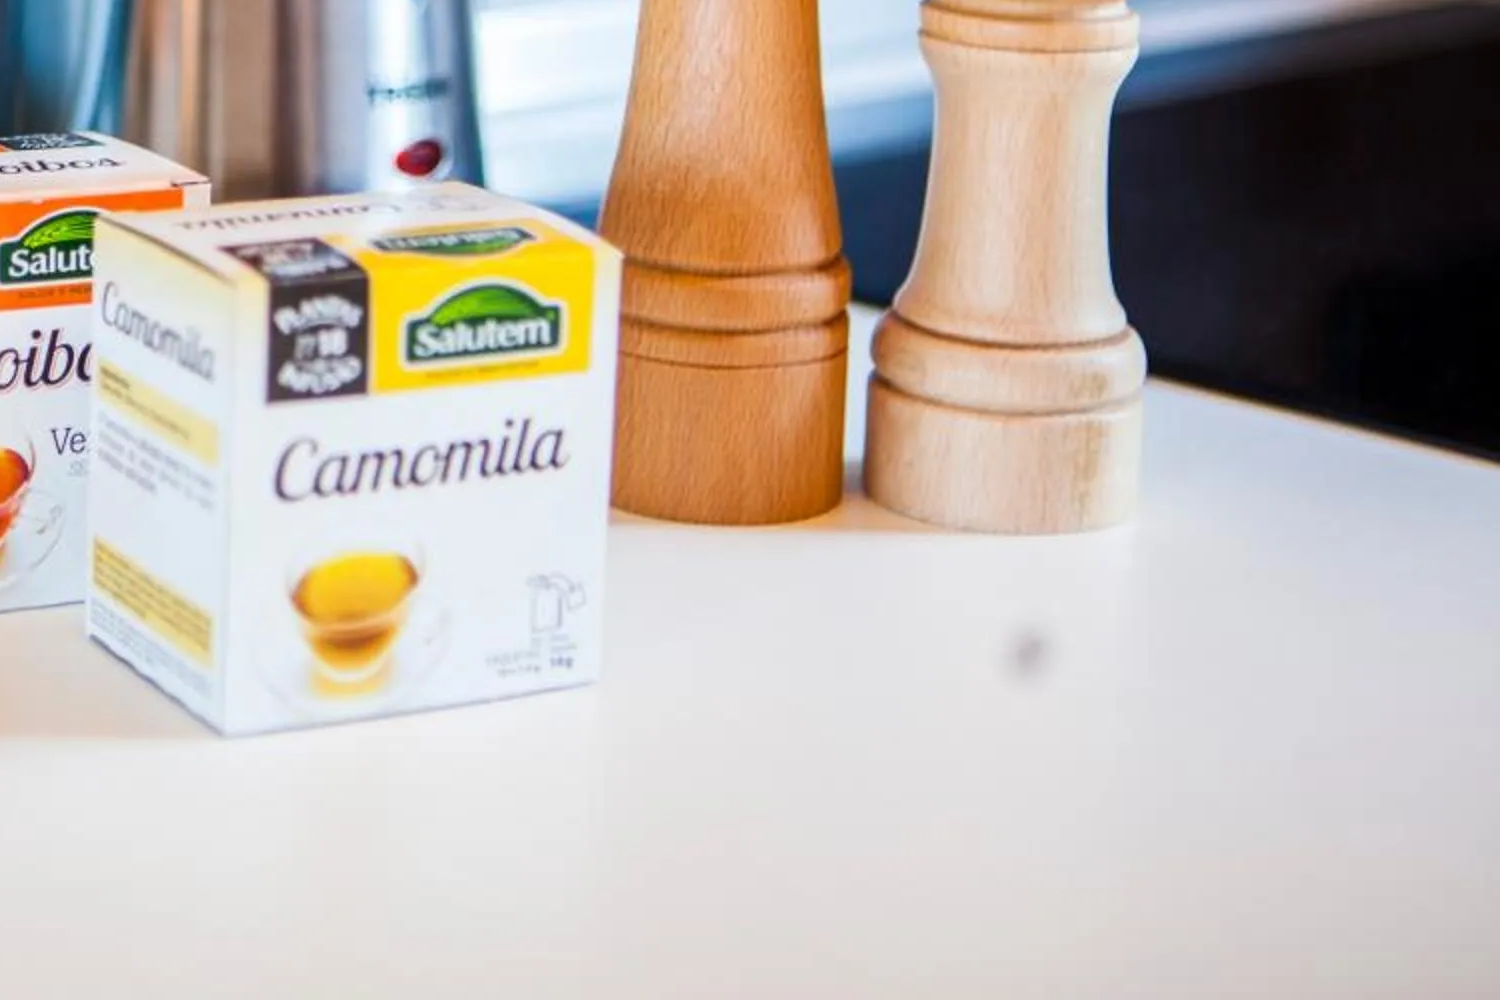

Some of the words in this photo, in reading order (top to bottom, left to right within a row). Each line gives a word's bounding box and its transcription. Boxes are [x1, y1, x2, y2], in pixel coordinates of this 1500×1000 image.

[100, 280, 217, 386] Camomila
[413, 315, 550, 359] Salutem
[51, 426, 89, 456] Ve
[273, 417, 571, 503] Camomila
